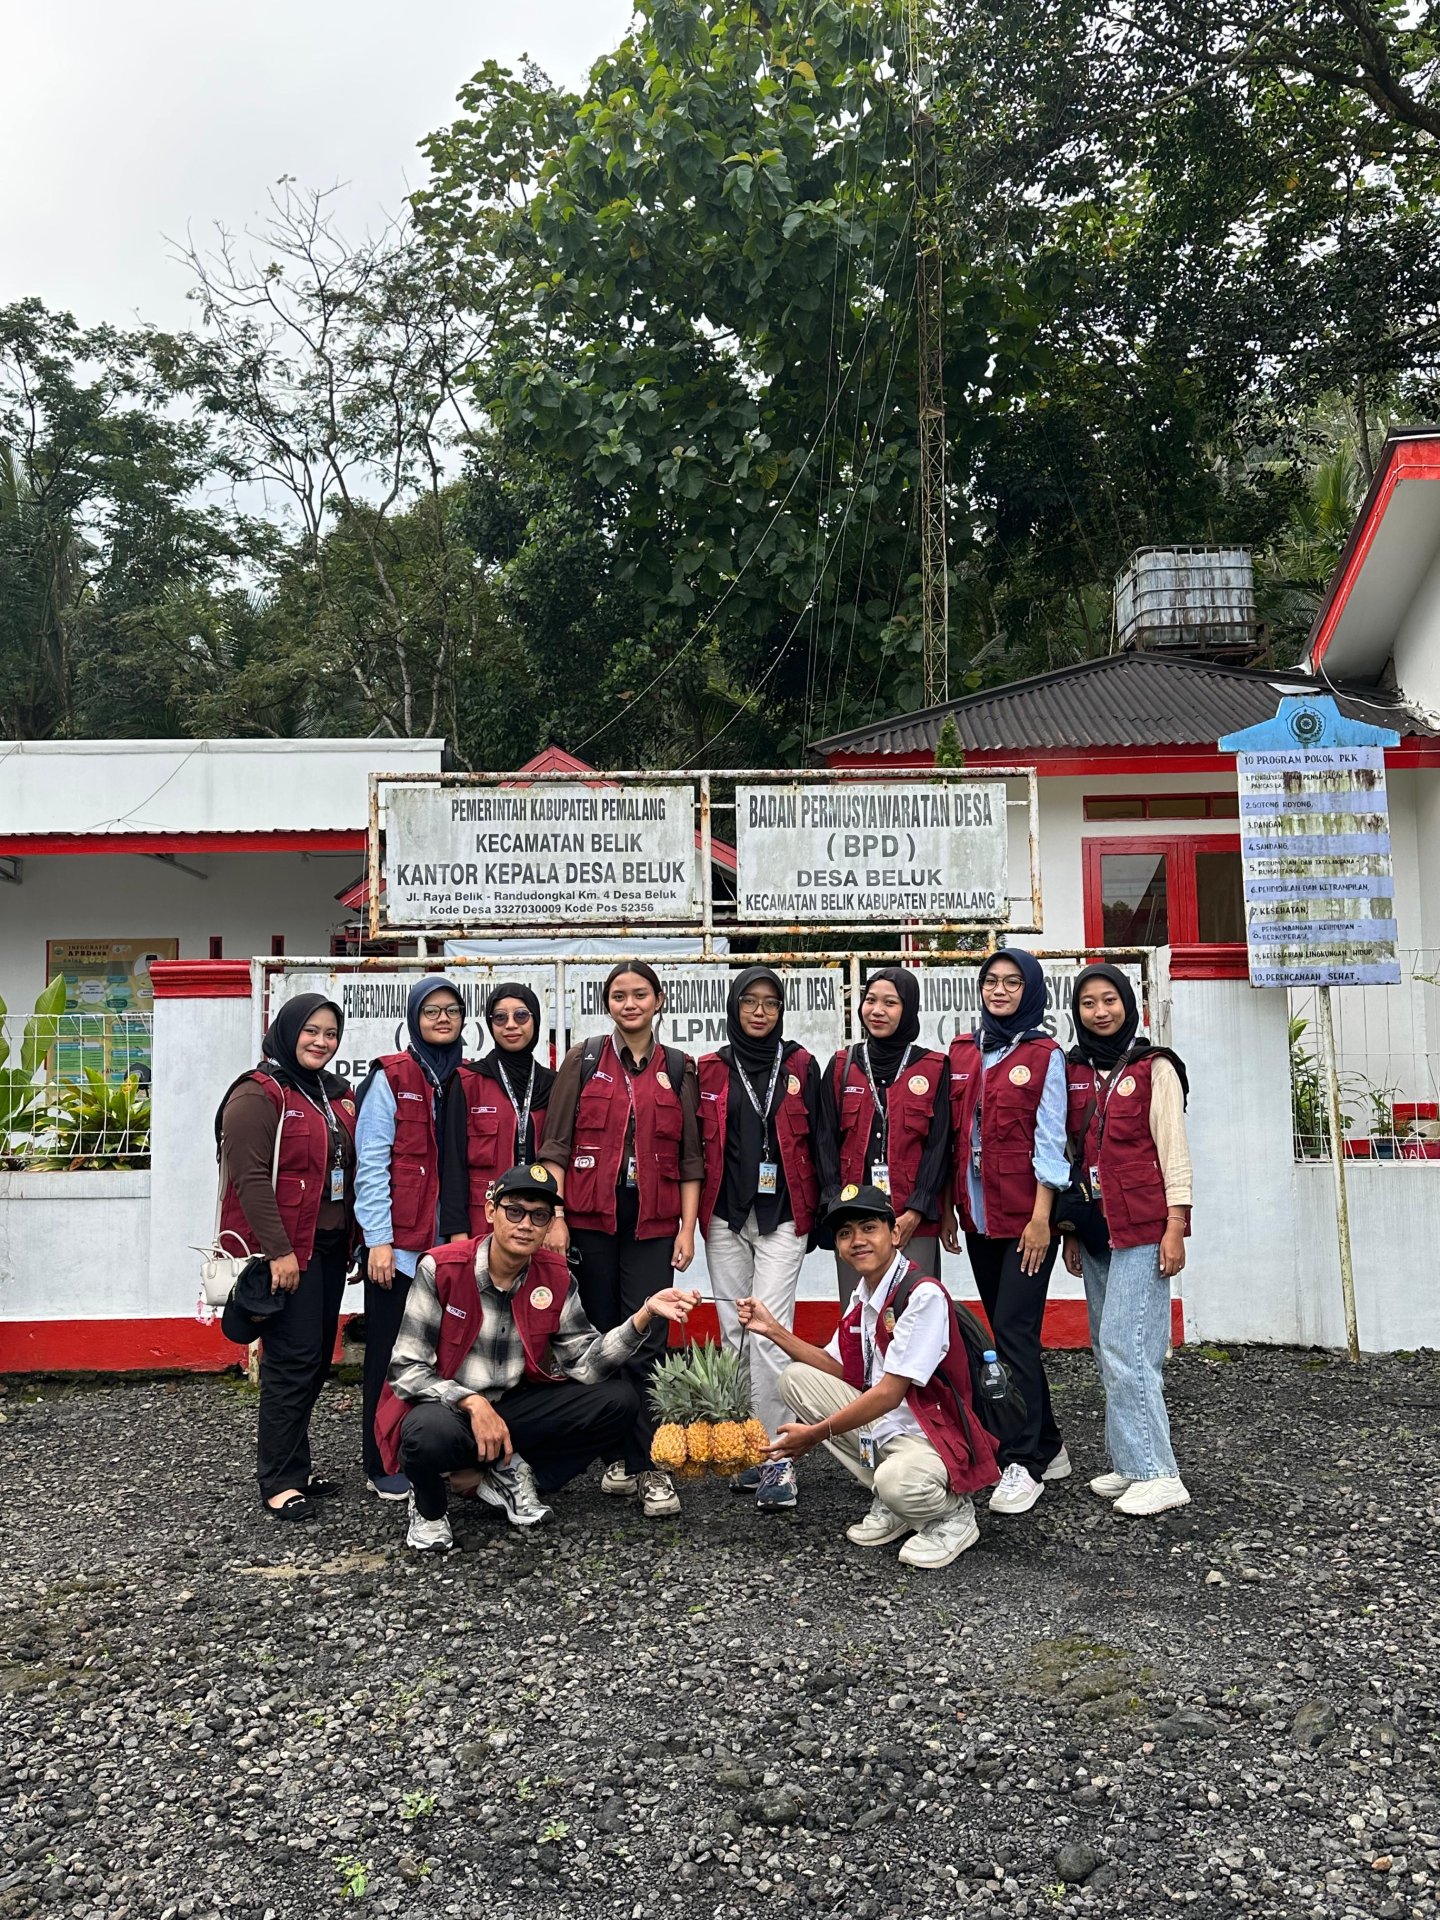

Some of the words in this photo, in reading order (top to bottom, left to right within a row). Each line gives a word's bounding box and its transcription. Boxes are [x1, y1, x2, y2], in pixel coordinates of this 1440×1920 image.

[1304, 754, 1335, 763] POKOK
[1339, 754, 1359, 763] PKK
[451, 798, 526, 821] PEMERINTAH
[530, 798, 598, 821] KABUPATEN
[602, 798, 666, 821] PEMALANG
[749, 794, 797, 828] BADAN
[801, 793, 950, 828] PERMUSYAWARATAN
[954, 792, 993, 826] DESA
[476, 833, 584, 853] KECAMATAN
[591, 833, 642, 853] BELIK
[397, 863, 478, 886] KANTOR
[485, 862, 559, 885] KEPALA
[566, 862, 616, 884] DESA
[622, 861, 685, 883] BELUK
[796, 869, 859, 887] DESA
[865, 868, 942, 886] BELUK
[423, 892, 451, 903] Raya
[454, 892, 483, 901] Belik
[494, 890, 575, 902] Randudongkal
[578, 890, 600, 900] Km.
[603, 891, 610, 900] 4
[613, 890, 642, 900] Desa
[645, 889, 677, 900] Beluk
[745, 893, 816, 911] KECAMATAN
[821, 893, 854, 910] BELIK
[857, 892, 927, 910] KABUPATEN
[930, 891, 996, 910] PEMALANG
[430, 904, 460, 915] Kode
[463, 904, 492, 914] Desa
[494, 903, 561, 914] 3327030009
[564, 903, 594, 913] Kode
[596, 902, 618, 913] Pos
[620, 902, 654, 912] 52356
[807, 977, 836, 1011] DESA
